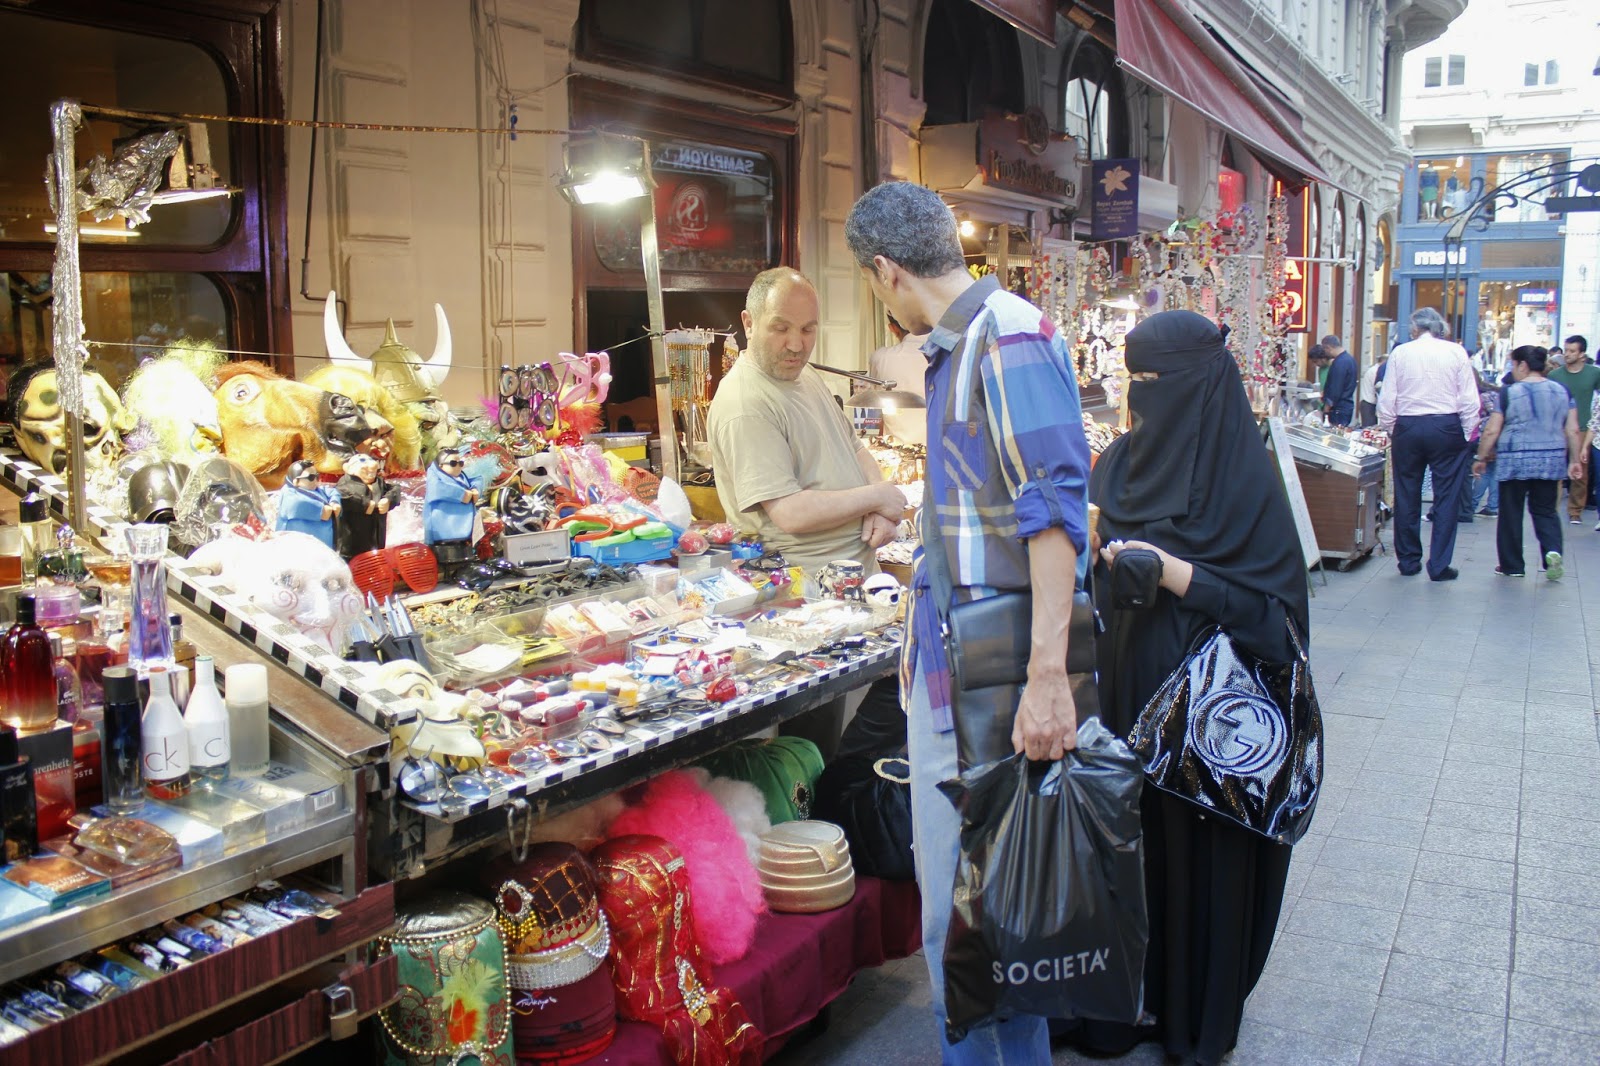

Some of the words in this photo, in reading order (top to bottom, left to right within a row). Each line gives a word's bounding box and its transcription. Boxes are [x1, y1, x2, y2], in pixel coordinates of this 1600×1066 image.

[1414, 247, 1467, 266] mavi
[144, 737, 181, 773] ck
[992, 947, 1110, 985] SOCIETA'
